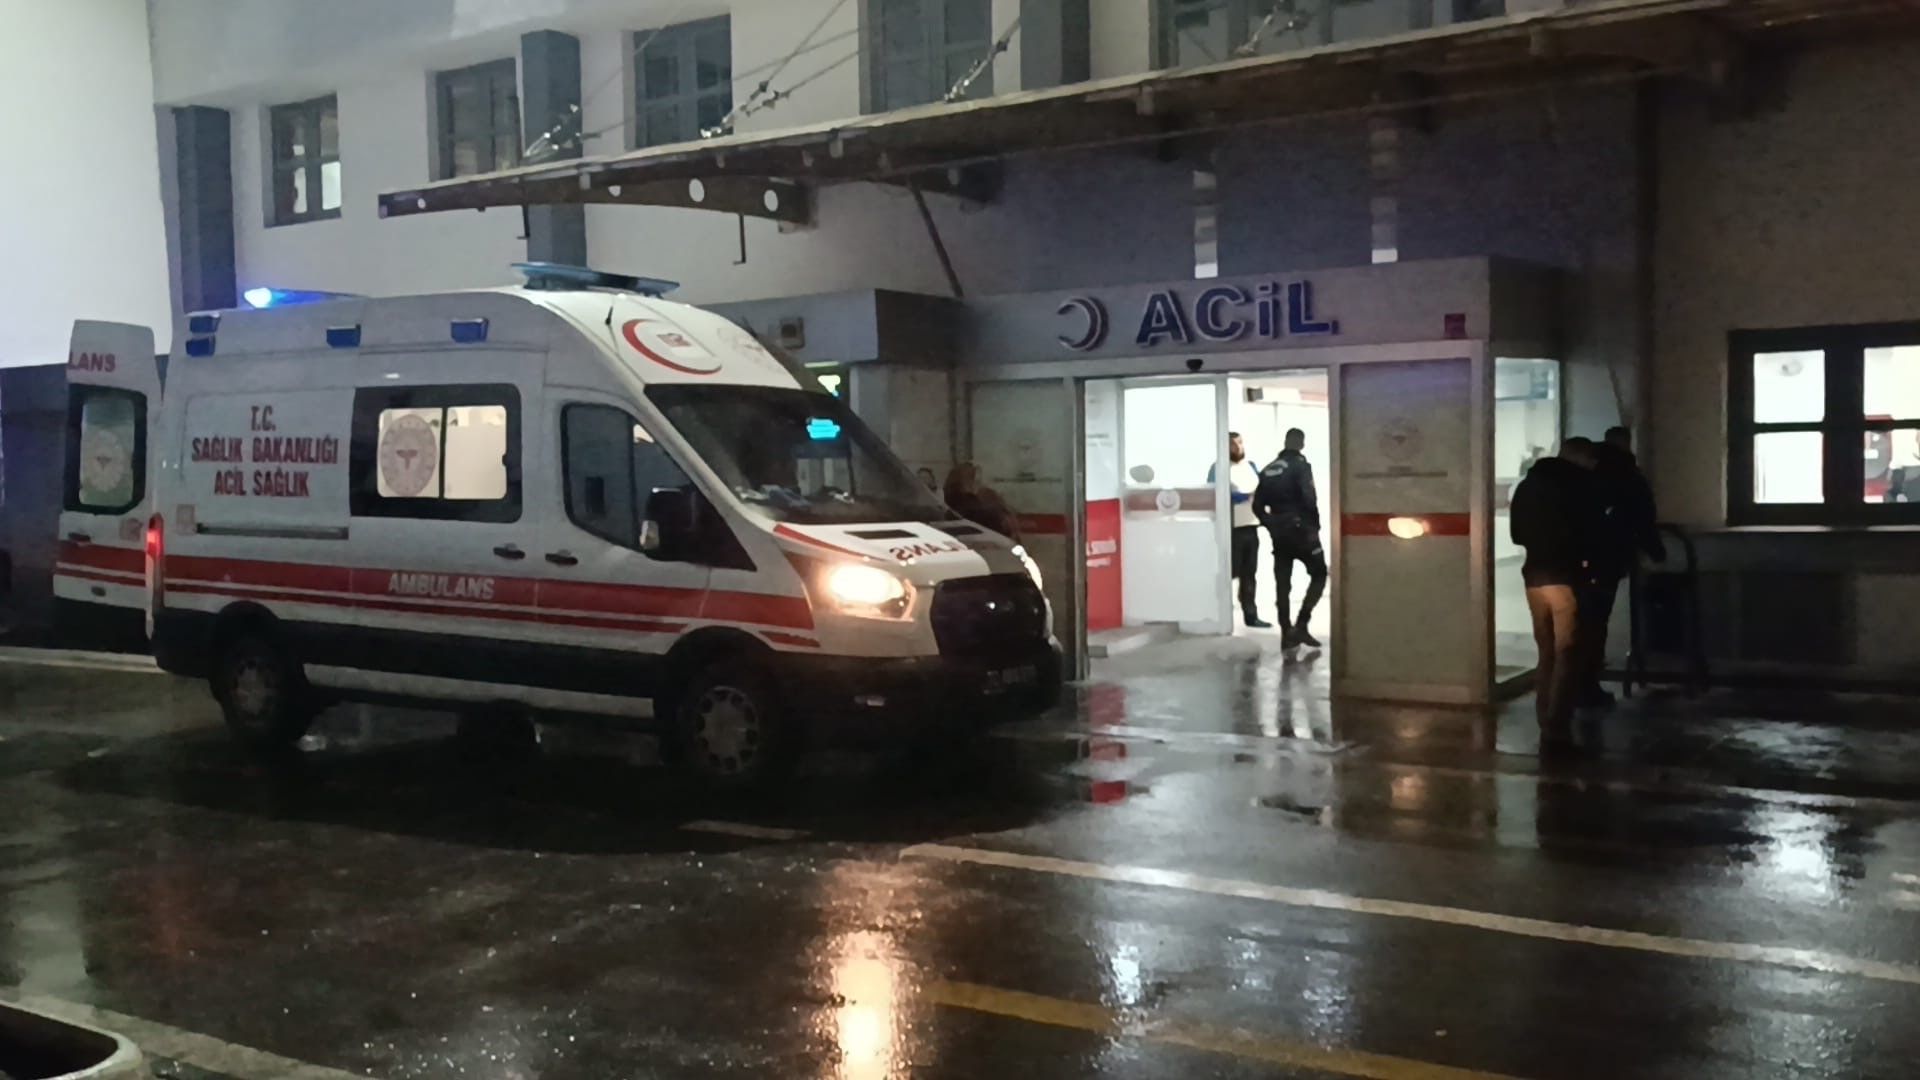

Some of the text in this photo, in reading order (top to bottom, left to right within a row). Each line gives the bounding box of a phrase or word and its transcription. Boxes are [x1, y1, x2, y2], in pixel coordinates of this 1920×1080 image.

[251, 405, 276, 431] T.C.
[192, 434, 338, 464] SAĞLIK BAKANLIĞI
[253, 467, 309, 497] SAĞLIK
[388, 572, 496, 600] AMBULANS
